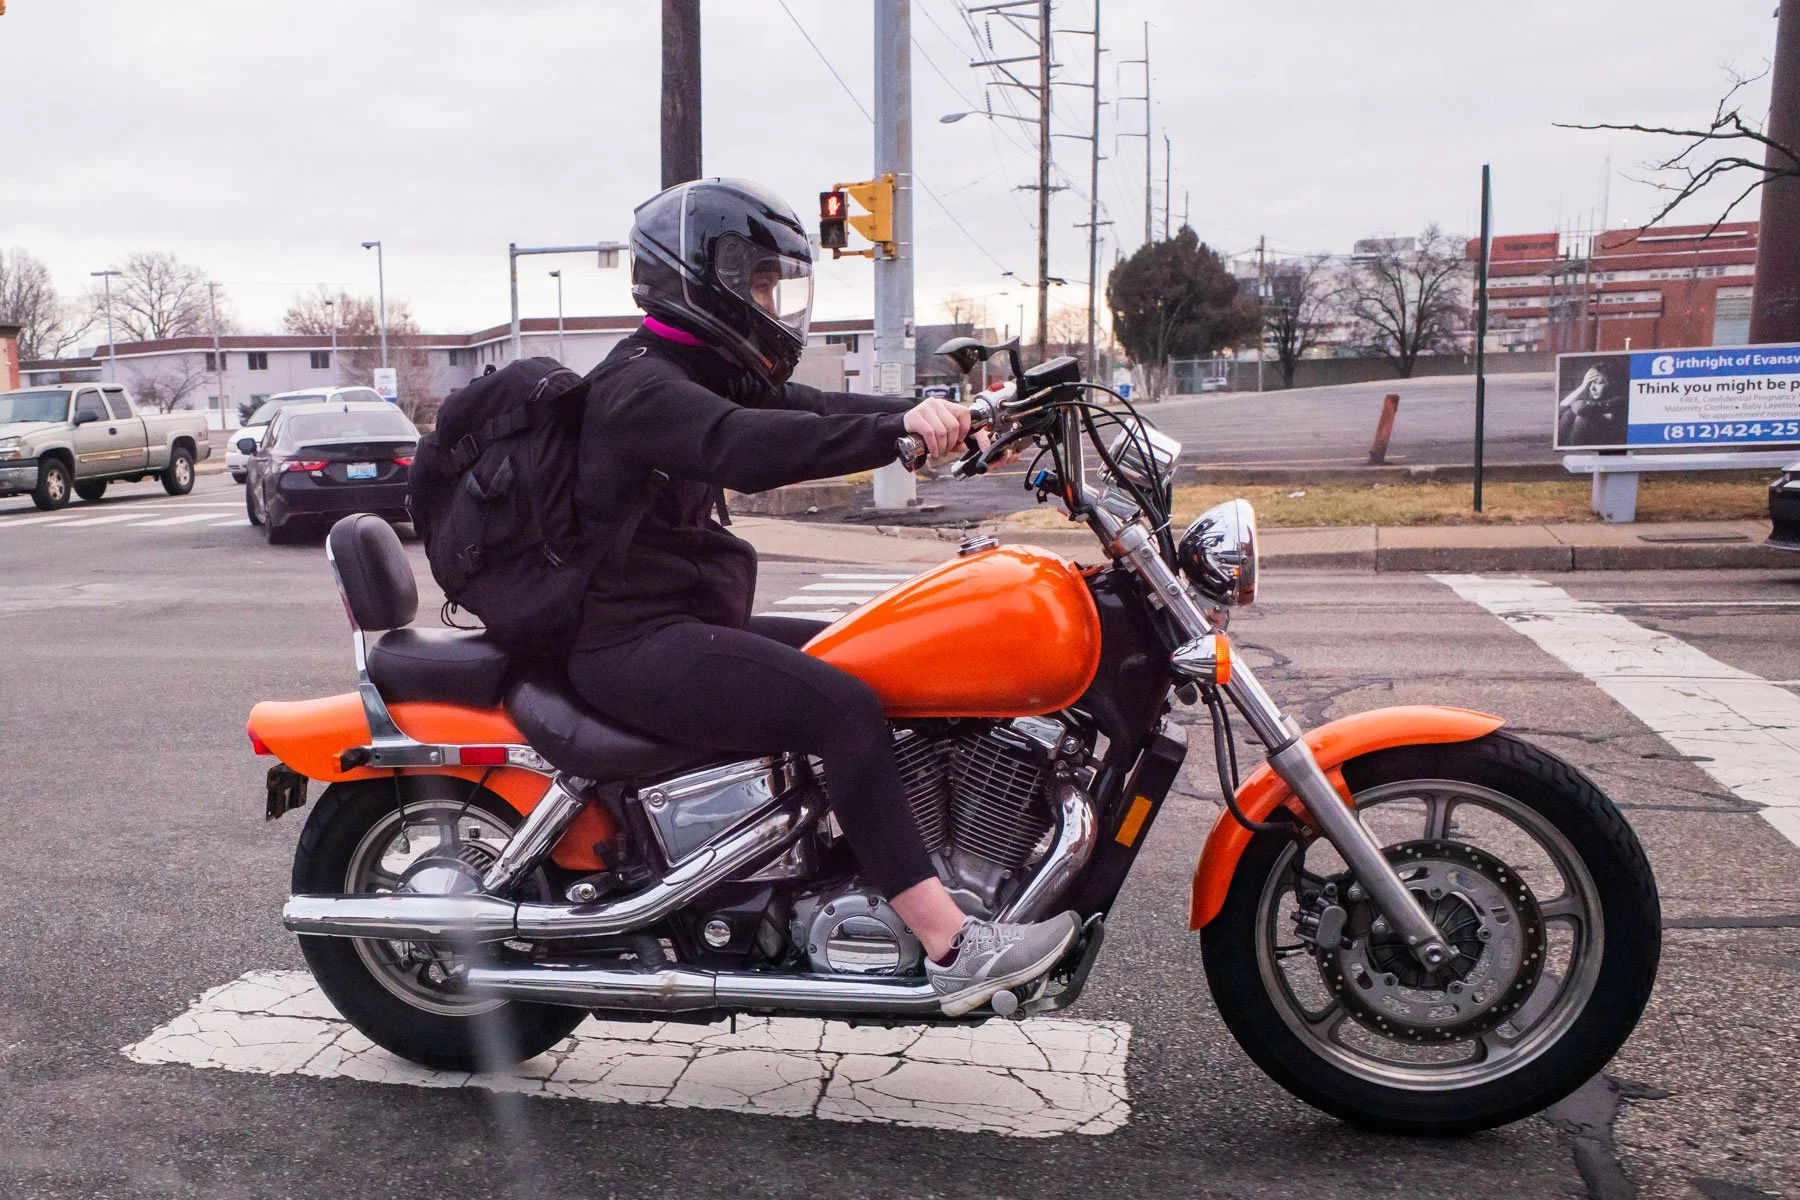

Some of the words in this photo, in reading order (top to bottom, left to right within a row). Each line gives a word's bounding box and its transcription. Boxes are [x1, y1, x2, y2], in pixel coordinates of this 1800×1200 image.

[1736, 355, 1750, 366] of
[1637, 382, 1679, 394] Think
[1684, 382, 1711, 396] you
[1716, 379, 1762, 394] might
[1767, 378, 1787, 390] be
[1753, 393, 1796, 402] Pregnancy
[1664, 405, 1702, 413] Maternity
